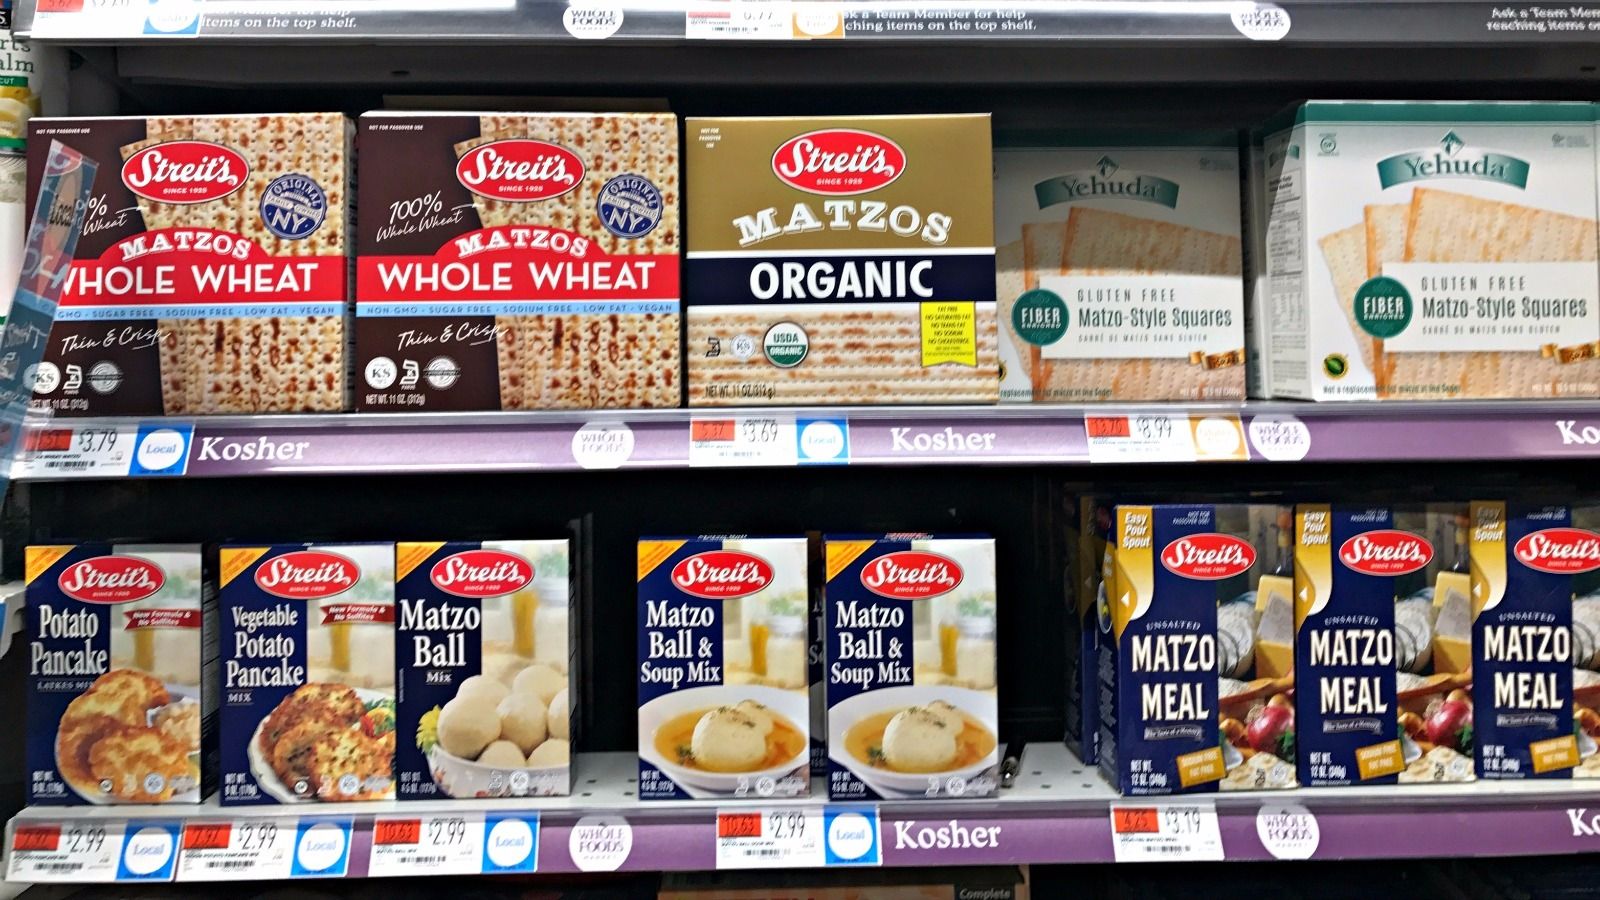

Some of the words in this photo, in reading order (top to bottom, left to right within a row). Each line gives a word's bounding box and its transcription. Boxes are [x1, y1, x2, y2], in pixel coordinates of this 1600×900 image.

[244, 19, 261, 29] on
[266, 15, 290, 29] the
[293, 17, 317, 30] top
[320, 14, 357, 29] shelf.
[571, 17, 617, 26] FOODS
[914, 9, 970, 19] Member
[974, 9, 994, 19] for
[997, 9, 1027, 21] help
[1529, 6, 1568, 18] Team
[887, 20, 924, 31] items
[928, 22, 945, 31] on
[949, 20, 971, 31] the
[975, 21, 997, 32] top
[1486, 19, 1547, 33] reaching
[128, 149, 239, 188] Streit's
[462, 147, 575, 185] Streit's
[779, 137, 896, 178] Streit's
[1405, 152, 1505, 178] Yehuda
[162, 187, 187, 195] SINCE
[273, 179, 321, 208] ORIGINAL
[498, 185, 523, 193] SINCE
[609, 179, 658, 207] ORIGINAL
[816, 178, 842, 186] SINCE
[1062, 174, 1157, 199] Yehuda
[388, 190, 444, 225] 100%
[608, 207, 644, 233] NY
[271, 207, 308, 234] NY
[375, 223, 418, 243] Whole
[418, 208, 464, 234] Wheat
[732, 200, 953, 248] MATZOS
[119, 231, 252, 262] MATZOS
[453, 228, 590, 259] MATZOS
[190, 262, 320, 295] WHEAT
[376, 262, 513, 292] WHOLE
[528, 261, 657, 291] WHEAT
[749, 259, 934, 300] ORGANIC
[1421, 276, 1478, 291] GLUTEN
[1489, 276, 1527, 291] FREE
[1077, 288, 1132, 303] GLUTEN
[1142, 288, 1177, 302] FREE
[1363, 296, 1404, 314] FIBER
[92, 310, 127, 318] SUGAR
[129, 309, 154, 317] FREE
[165, 309, 206, 317] SODIUM
[209, 308, 234, 317] FREE
[245, 308, 268, 316] LOW
[271, 307, 288, 315] FAT
[300, 306, 335, 315] VEGAN
[429, 306, 463, 314] SUGAR
[467, 305, 492, 314] FREE
[503, 305, 545, 313] SODIUM
[548, 305, 573, 313] FREE
[583, 304, 606, 313] LOW
[609, 304, 627, 313] FAT
[638, 304, 673, 312] VEGAN
[1021, 307, 1061, 323] FIBER
[1078, 307, 1167, 329] Matzo-Style
[1172, 308, 1233, 329] Squares
[1422, 296, 1516, 321] Matzo-Style
[1521, 297, 1588, 321] Squares
[61, 335, 101, 357] Thin
[103, 328, 116, 348] &
[119, 325, 172, 350] Crisp
[397, 331, 437, 352] Thin
[440, 323, 453, 343] &
[455, 321, 510, 346] Crisp
[772, 332, 799, 344] USDA
[705, 385, 719, 398] NET
[733, 385, 740, 397] 11
[742, 420, 779, 443] $3.69
[890, 427, 997, 452] Kosher
[1136, 416, 1172, 439] $8.99
[79, 430, 119, 453] $3.79
[145, 443, 176, 455] Local
[197, 436, 310, 461] Kosher
[1124, 511, 1148, 524] Easy
[1303, 510, 1327, 524] Easy
[1304, 522, 1326, 534] Pour
[1122, 536, 1151, 549] Spout
[1125, 524, 1148, 536] Pour
[1301, 533, 1328, 547] Spout
[1474, 530, 1504, 543] Spout
[1166, 539, 1249, 569] Streit's
[1344, 536, 1427, 564] Streit's
[63, 562, 157, 593] Streit's
[260, 557, 352, 588] Streit's
[435, 556, 527, 587] Streit's
[676, 557, 766, 587] Streit's
[865, 557, 956, 587] Streit's
[38, 604, 99, 639] Potato
[151, 610, 183, 618] Formula
[231, 603, 299, 634] Vegetable
[329, 606, 346, 614] New
[347, 606, 378, 614] Formula
[398, 598, 481, 631] Matzo
[645, 600, 715, 628] Matzo
[835, 600, 905, 629] Matzo
[1324, 614, 1380, 626] UNSALTED
[1498, 612, 1556, 623] UNSALTED
[1145, 619, 1201, 632] UNSALTED
[234, 630, 295, 659] Potato
[412, 632, 467, 668] Ball
[648, 629, 694, 659] Ball
[698, 636, 713, 659] &
[838, 629, 884, 660] Ball
[888, 637, 904, 659] &
[1131, 633, 1216, 673] MATZO
[1309, 629, 1393, 667] MATZO
[1483, 625, 1571, 663] MATZO
[30, 639, 108, 676] Pancake
[225, 658, 304, 688] Pancake
[425, 671, 452, 683] Mix
[640, 661, 684, 690] Soup
[686, 661, 721, 683] Mix
[830, 661, 874, 690] Soup
[877, 661, 912, 684] Mix
[227, 692, 252, 703] MIX
[1141, 682, 1211, 722] MEAL
[1320, 677, 1388, 715] MEAL
[1493, 671, 1565, 710] MEAL
[428, 820, 466, 845] $2.99
[578, 828, 624, 840] WHOLE
[769, 813, 806, 839] $2.99
[894, 819, 1002, 849] Kosher
[1165, 809, 1201, 834] $3.19
[66, 827, 107, 853] $2.99
[237, 823, 278, 850] $2.99
[306, 839, 338, 852] Local
[495, 834, 526, 848] Local
[578, 840, 624, 853] FOODS
[835, 828, 866, 841] Local
[132, 842, 166, 857] Local
[959, 887, 1011, 900] Complete
